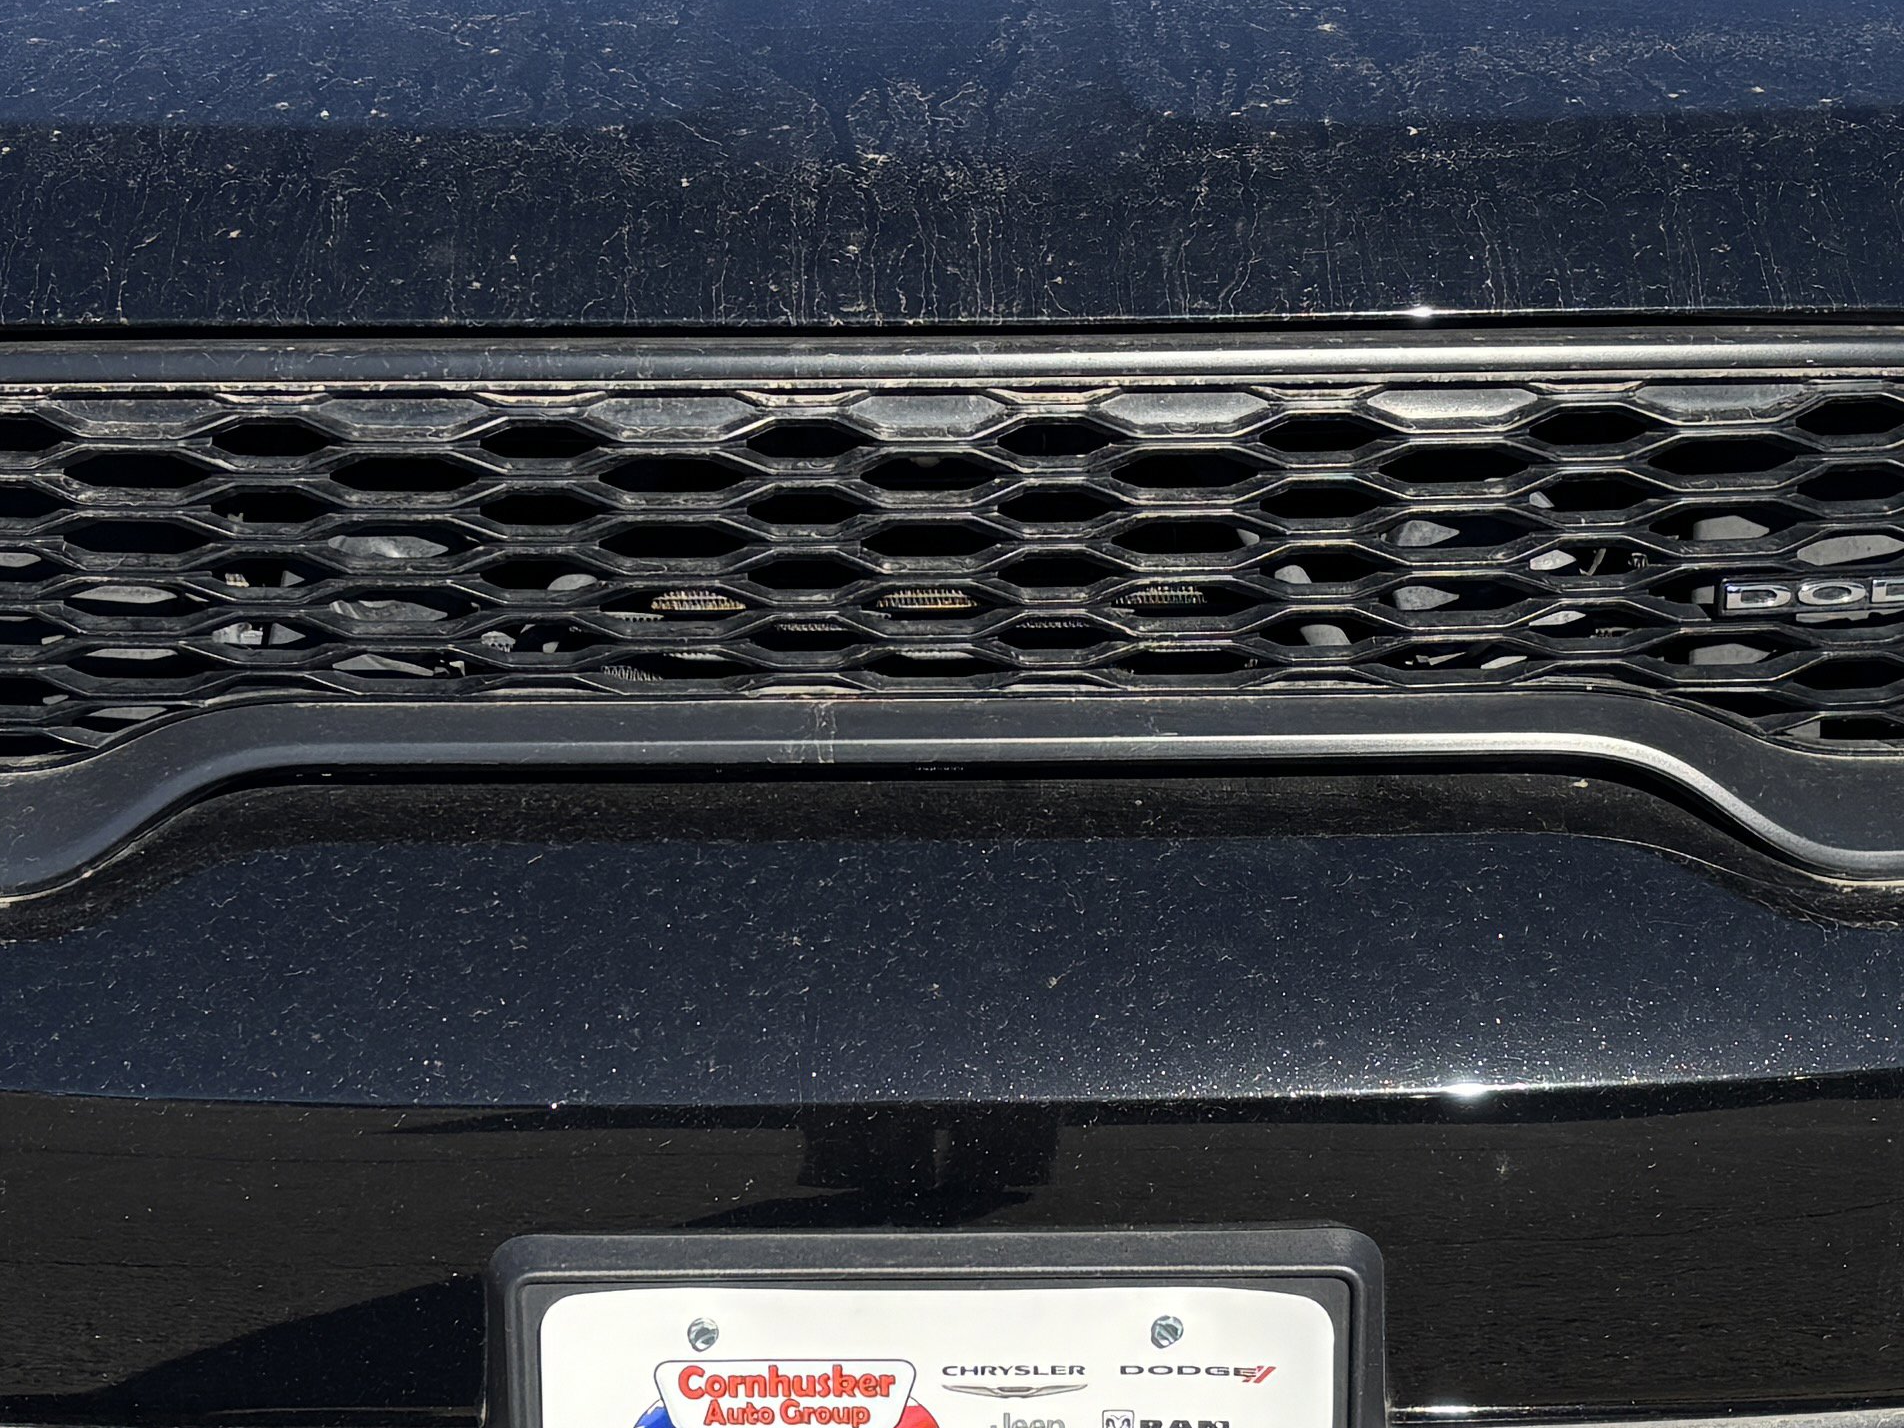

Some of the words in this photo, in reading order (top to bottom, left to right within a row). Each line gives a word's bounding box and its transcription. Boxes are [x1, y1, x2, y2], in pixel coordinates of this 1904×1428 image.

[942, 1365, 1086, 1376] CHRYSLER
[1120, 1365, 1257, 1378] DODGE
[678, 1364, 896, 1400] Cornhusker
[703, 1398, 775, 1426] Auto
[780, 1398, 871, 1428] Group
